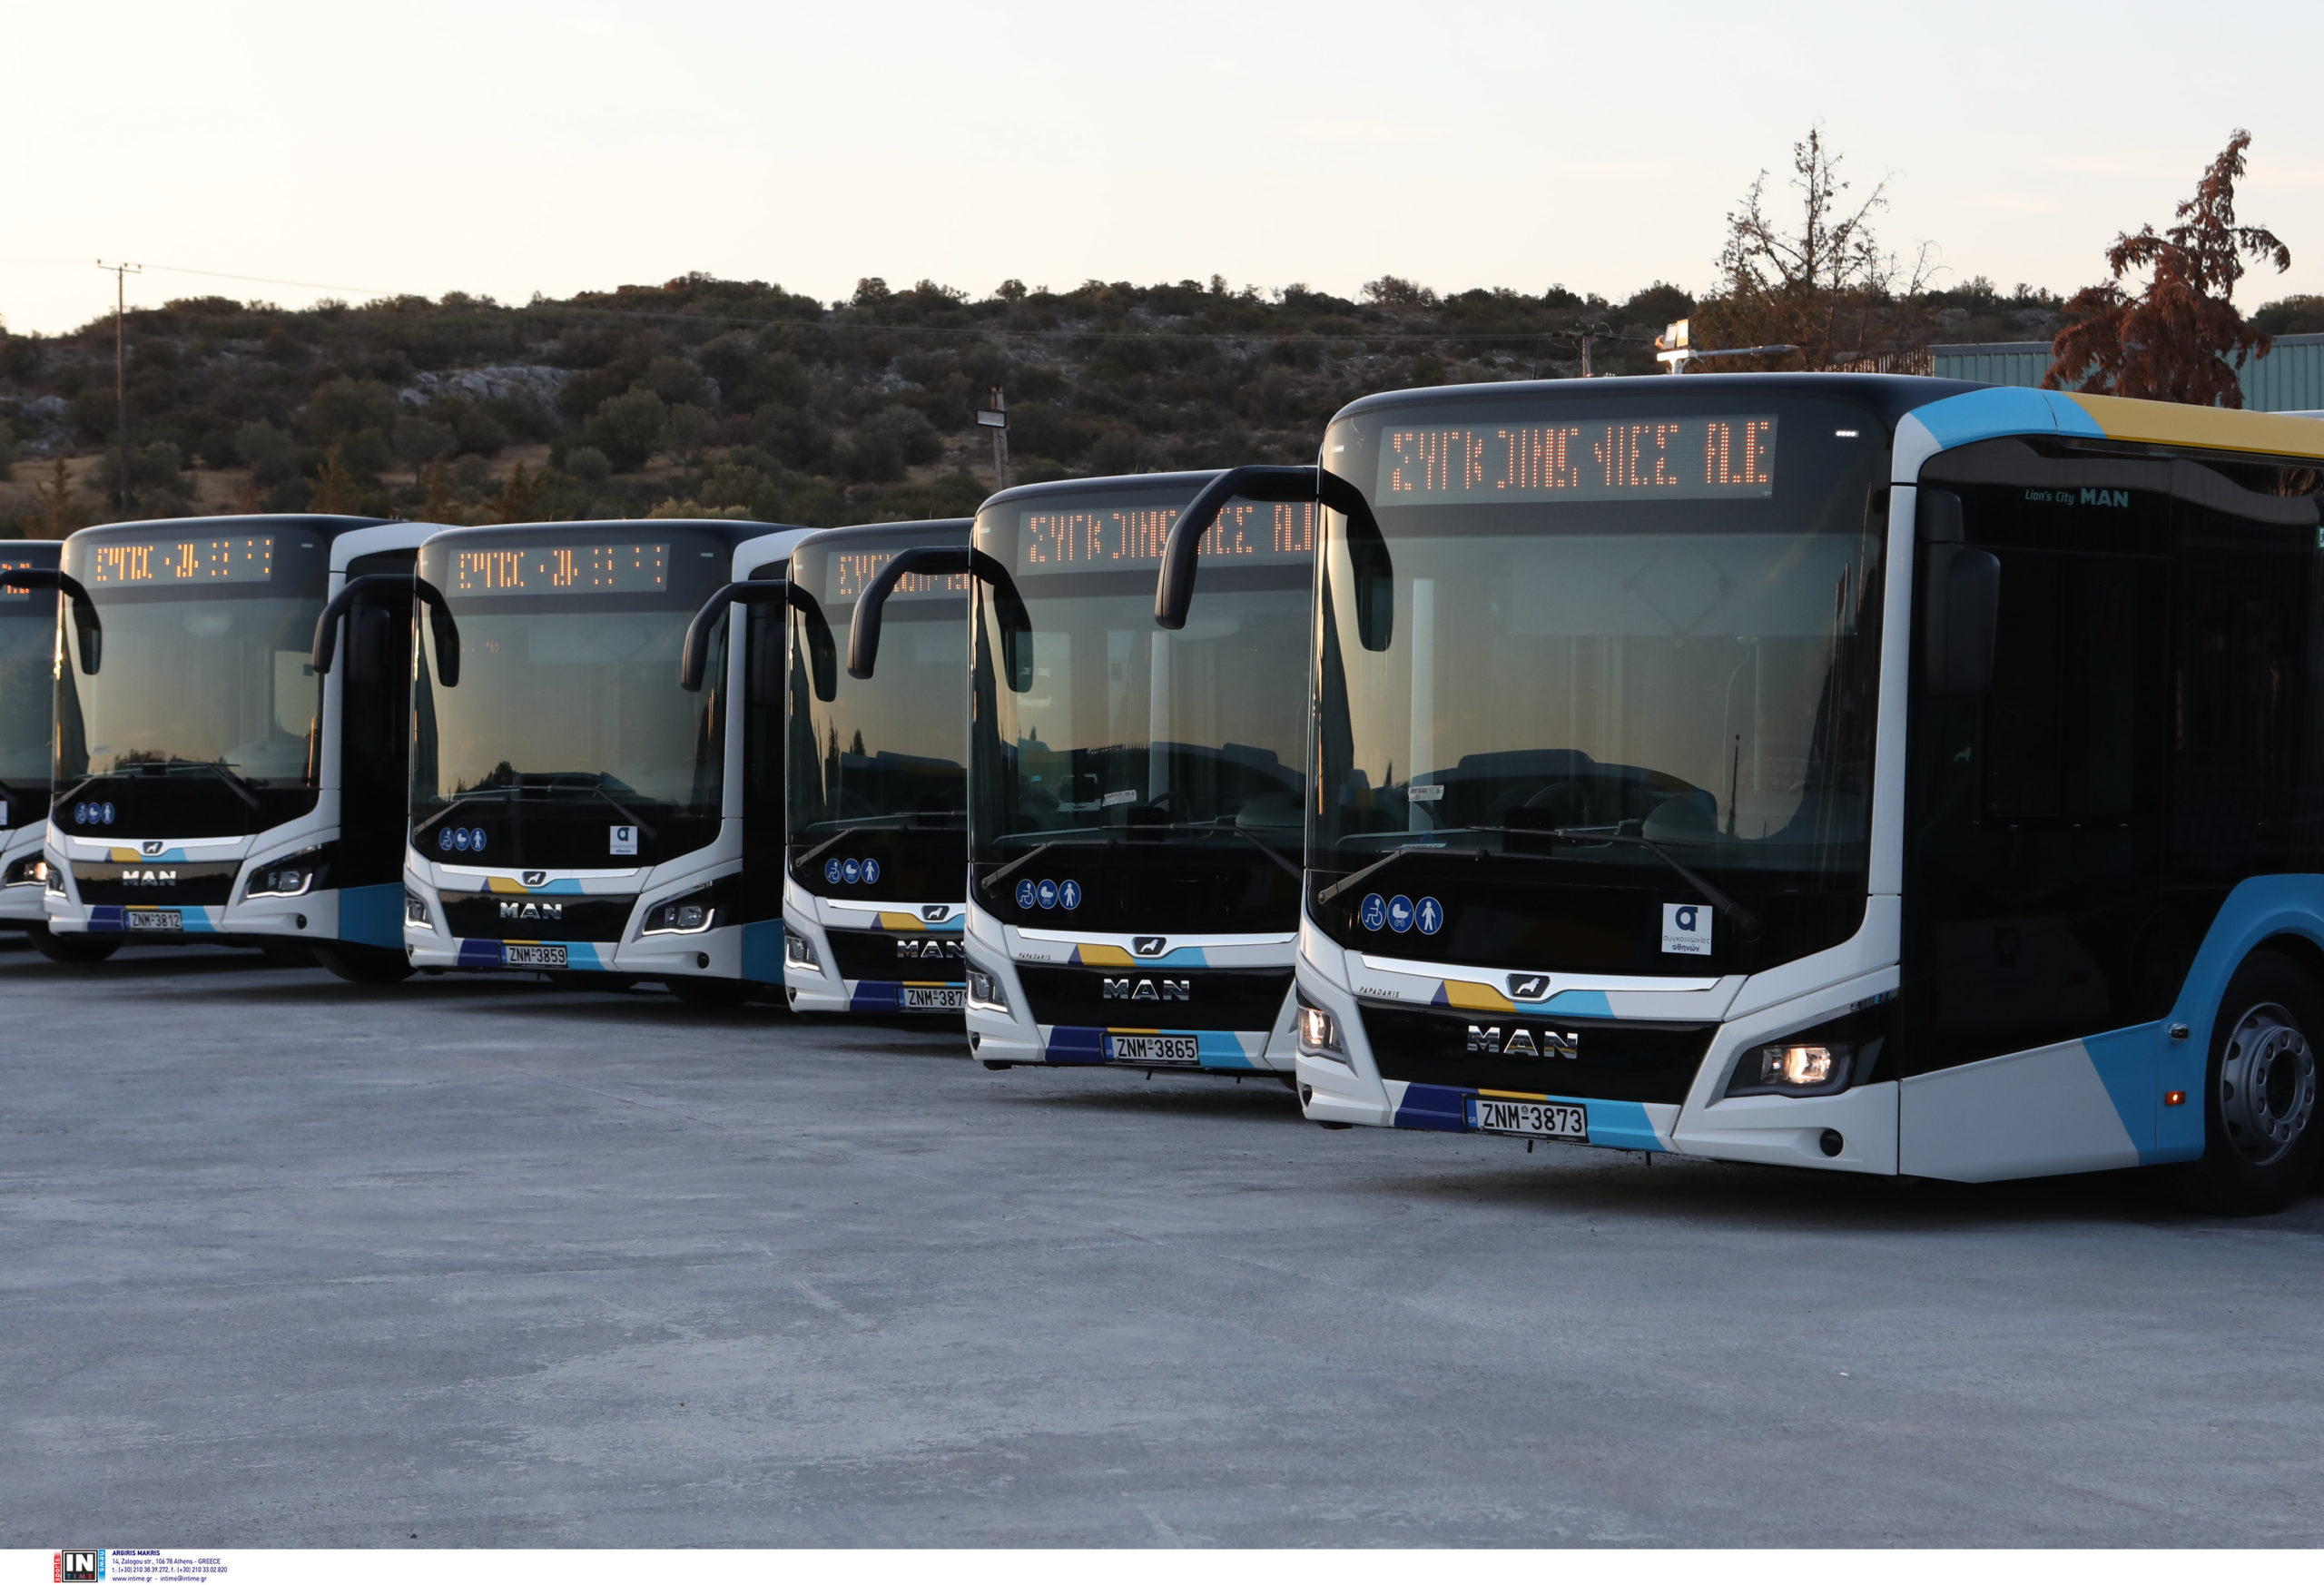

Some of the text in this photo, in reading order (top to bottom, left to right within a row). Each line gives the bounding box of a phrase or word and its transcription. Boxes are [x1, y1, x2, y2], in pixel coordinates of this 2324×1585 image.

[2025, 487, 2129, 507] Lion's City MAN
[123, 871, 177, 886] MAN
[500, 902, 562, 920] MAN
[508, 947, 566, 963] ZNM-3859
[1103, 979, 1190, 1000] MAN
[1359, 986, 1400, 998] PAPADAKIS
[1117, 1038, 1196, 1058] ZNM-3865
[1467, 1025, 1580, 1059] MAN
[1482, 1103, 1582, 1133] ZNM-3873
